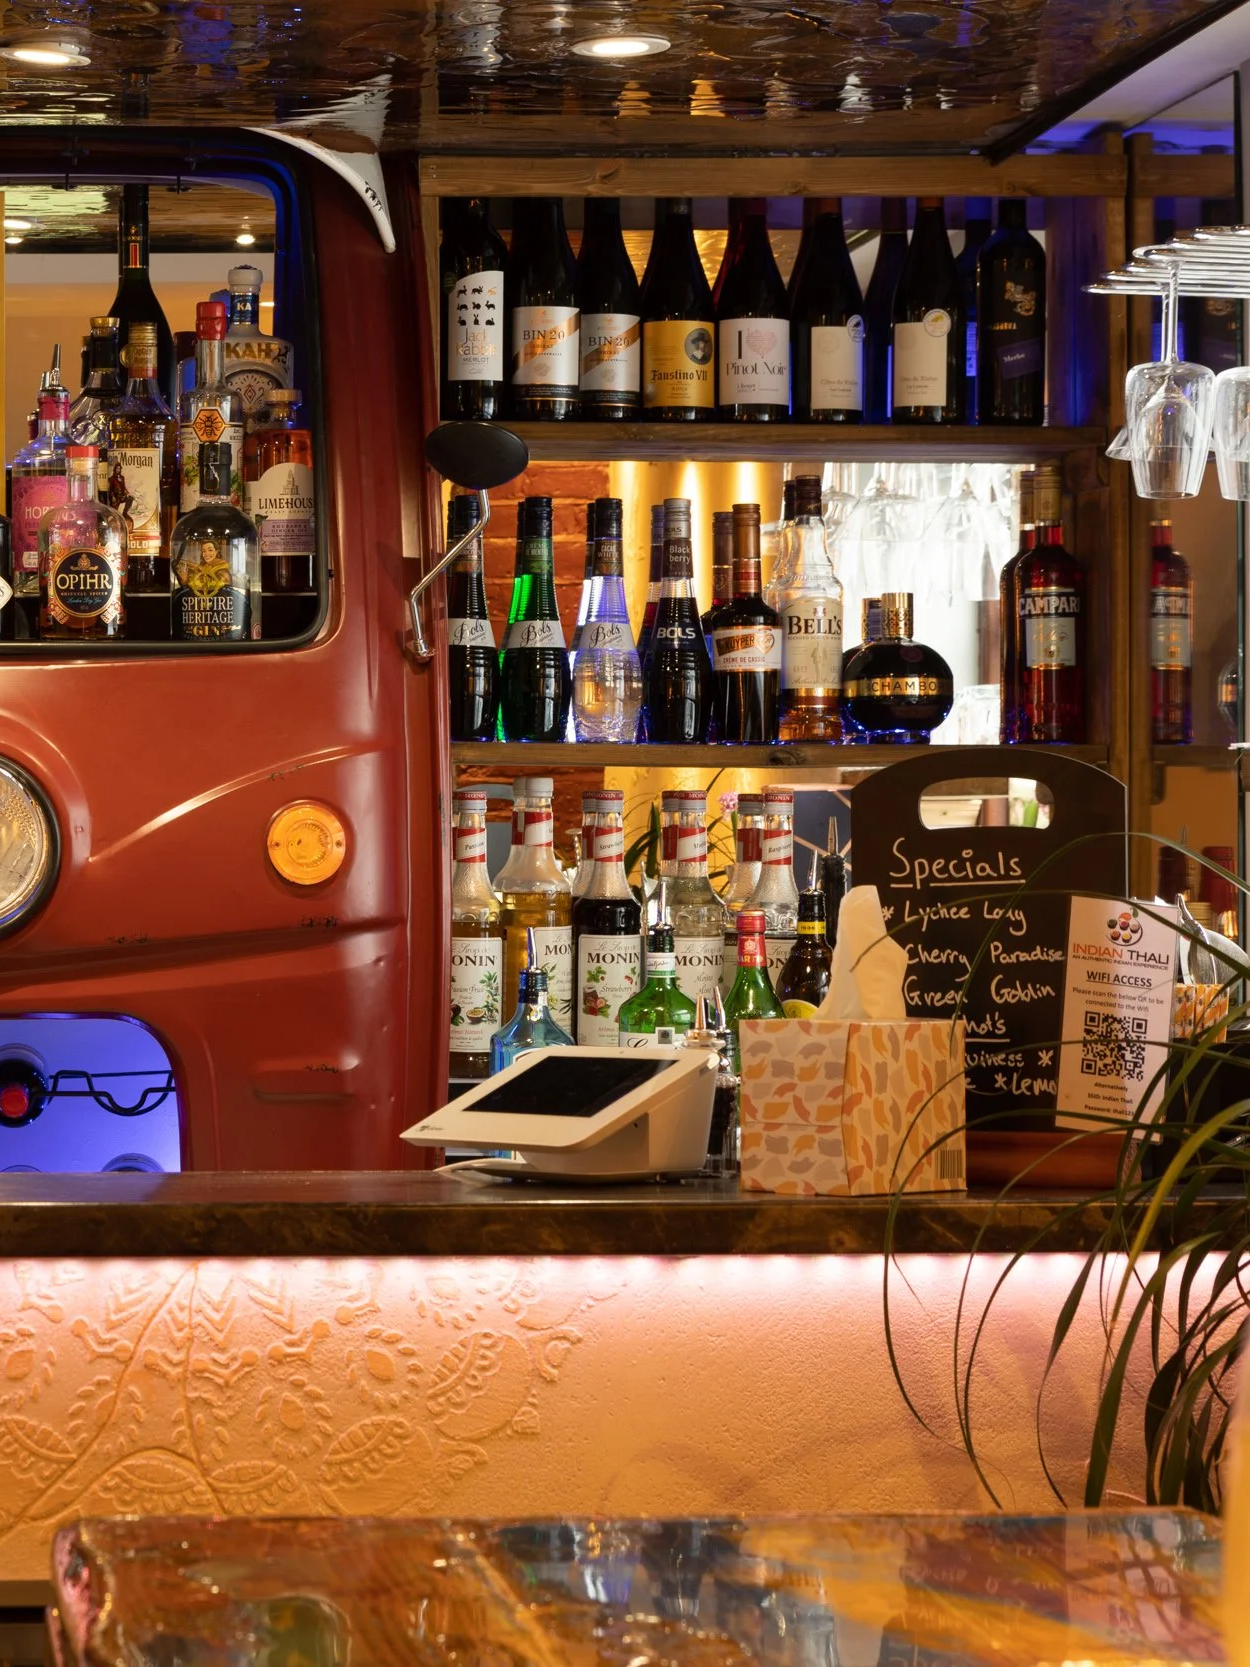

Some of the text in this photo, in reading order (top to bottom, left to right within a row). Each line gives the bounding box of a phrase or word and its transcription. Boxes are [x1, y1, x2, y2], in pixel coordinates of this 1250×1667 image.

[523, 330, 565, 340] BIN 20
[589, 337, 630, 347] BIN 20
[225, 342, 275, 359] KAH
[726, 361, 787, 376] Pinot Noir
[651, 370, 708, 383] Faustino VII
[119, 452, 154, 469] Morgan
[258, 497, 314, 510] LIMEHOUS
[669, 545, 691, 553] Black
[669, 554, 691, 564] berry
[56, 573, 113, 590] OPIHR
[182, 596, 234, 611] SPITFIRE
[1019, 595, 1080, 614] CAMPARI
[182, 612, 234, 624] HERITAGE
[787, 615, 842, 635] BELL'S
[193, 625, 220, 636] GIN
[453, 620, 485, 646] Bols
[520, 620, 552, 647] Bols
[589, 622, 621, 648] Bols
[656, 627, 696, 639] BOLS
[726, 634, 755, 650] KUYPER
[871, 681, 938, 692] CHAMBO
[889, 837, 1023, 889] Specials
[904, 900, 971, 932] Lychee
[544, 943, 572, 956] MON
[1072, 943, 1170, 965] INDIAN THALI
[452, 955, 495, 966] ONIN
[587, 953, 640, 964] MONIN
[674, 955, 724, 966] MONIN
[903, 941, 1066, 982] Cherry Paradise
[1081, 955, 1112, 964] AUTHENTIC
[1132, 962, 1169, 971] EXPERIENCE
[1086, 970, 1152, 988] WIFI ACCESS
[599, 984, 632, 994] Strawberry
[904, 975, 1056, 1006] Green Goblin
[1072, 987, 1091, 996] Please
[1118, 991, 1136, 1001] below
[1137, 995, 1147, 1004] QR
[1155, 997, 1164, 1005] be
[1085, 999, 1117, 1008] connected
[964, 1050, 1025, 1069] uiness
[1094, 1081, 1128, 1092] Alternatively
[1120, 1096, 1133, 1104] Thali
[1084, 1104, 1111, 1113] Password:
